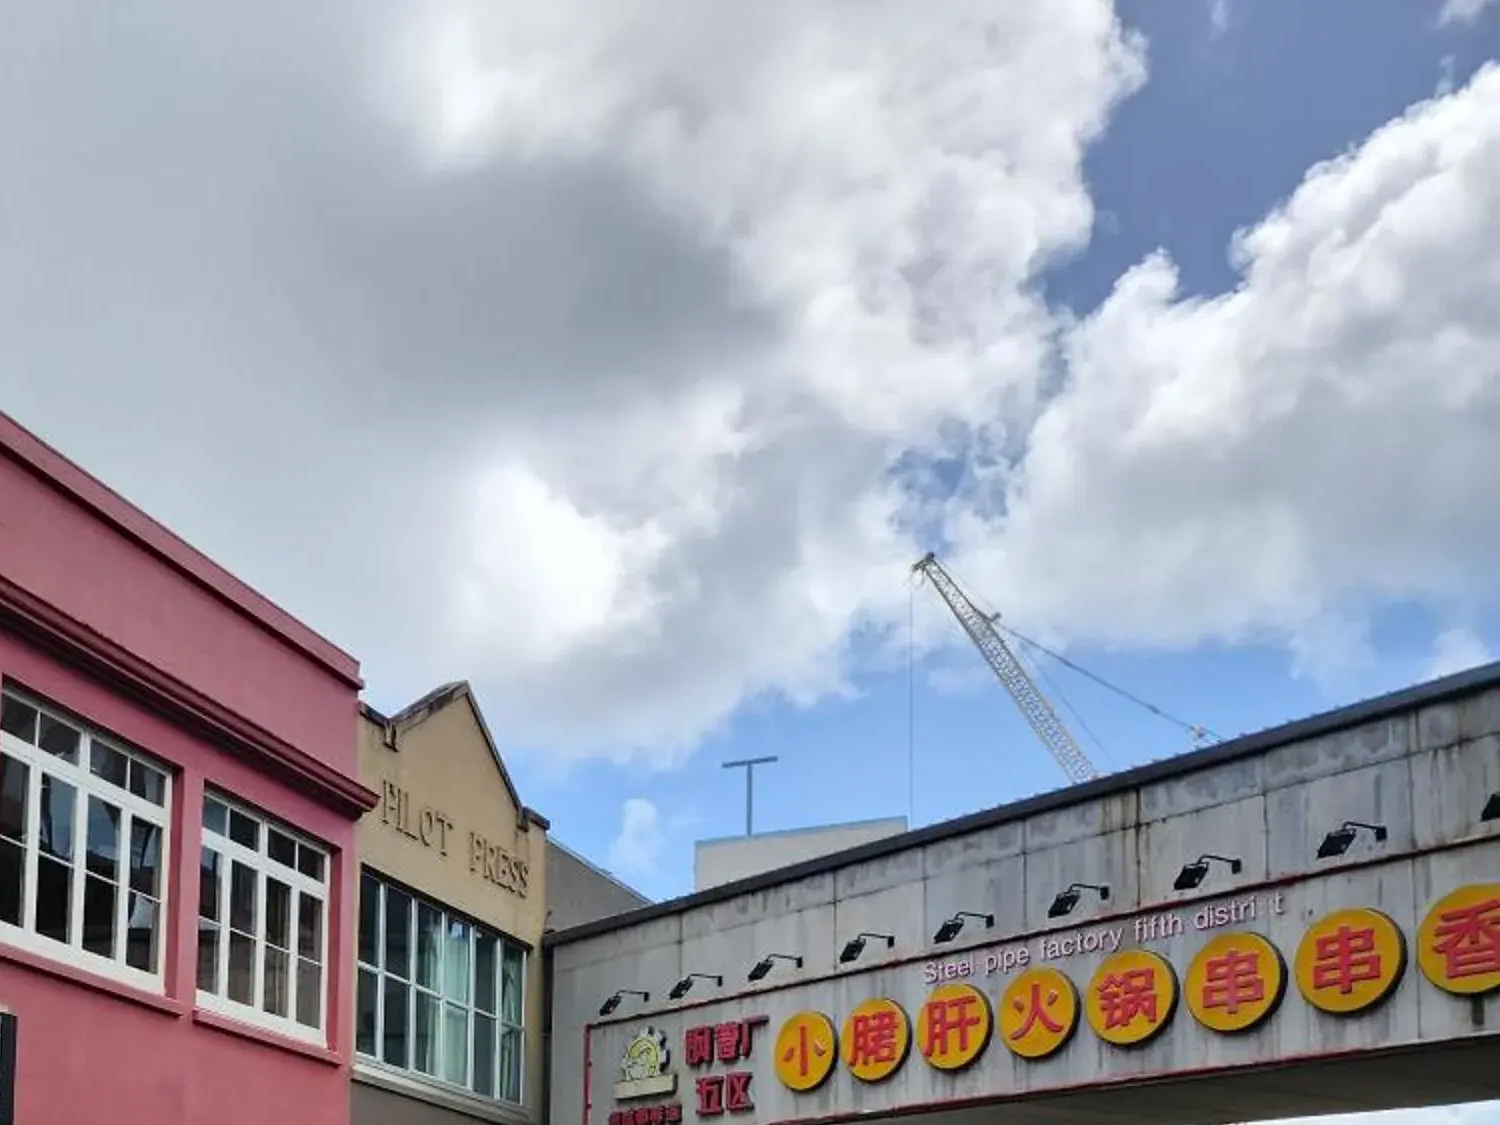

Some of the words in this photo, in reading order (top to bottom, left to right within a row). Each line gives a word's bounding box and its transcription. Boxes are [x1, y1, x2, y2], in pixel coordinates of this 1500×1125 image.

[375, 779, 454, 858] PILOT
[467, 830, 530, 900] PRESS
[923, 957, 975, 986] Steel
[985, 947, 1030, 974] pipe
[1039, 924, 1124, 962] factory
[1133, 911, 1184, 944] fifth
[1193, 891, 1285, 931] distrit
[695, 1070, 755, 1116] 五区
